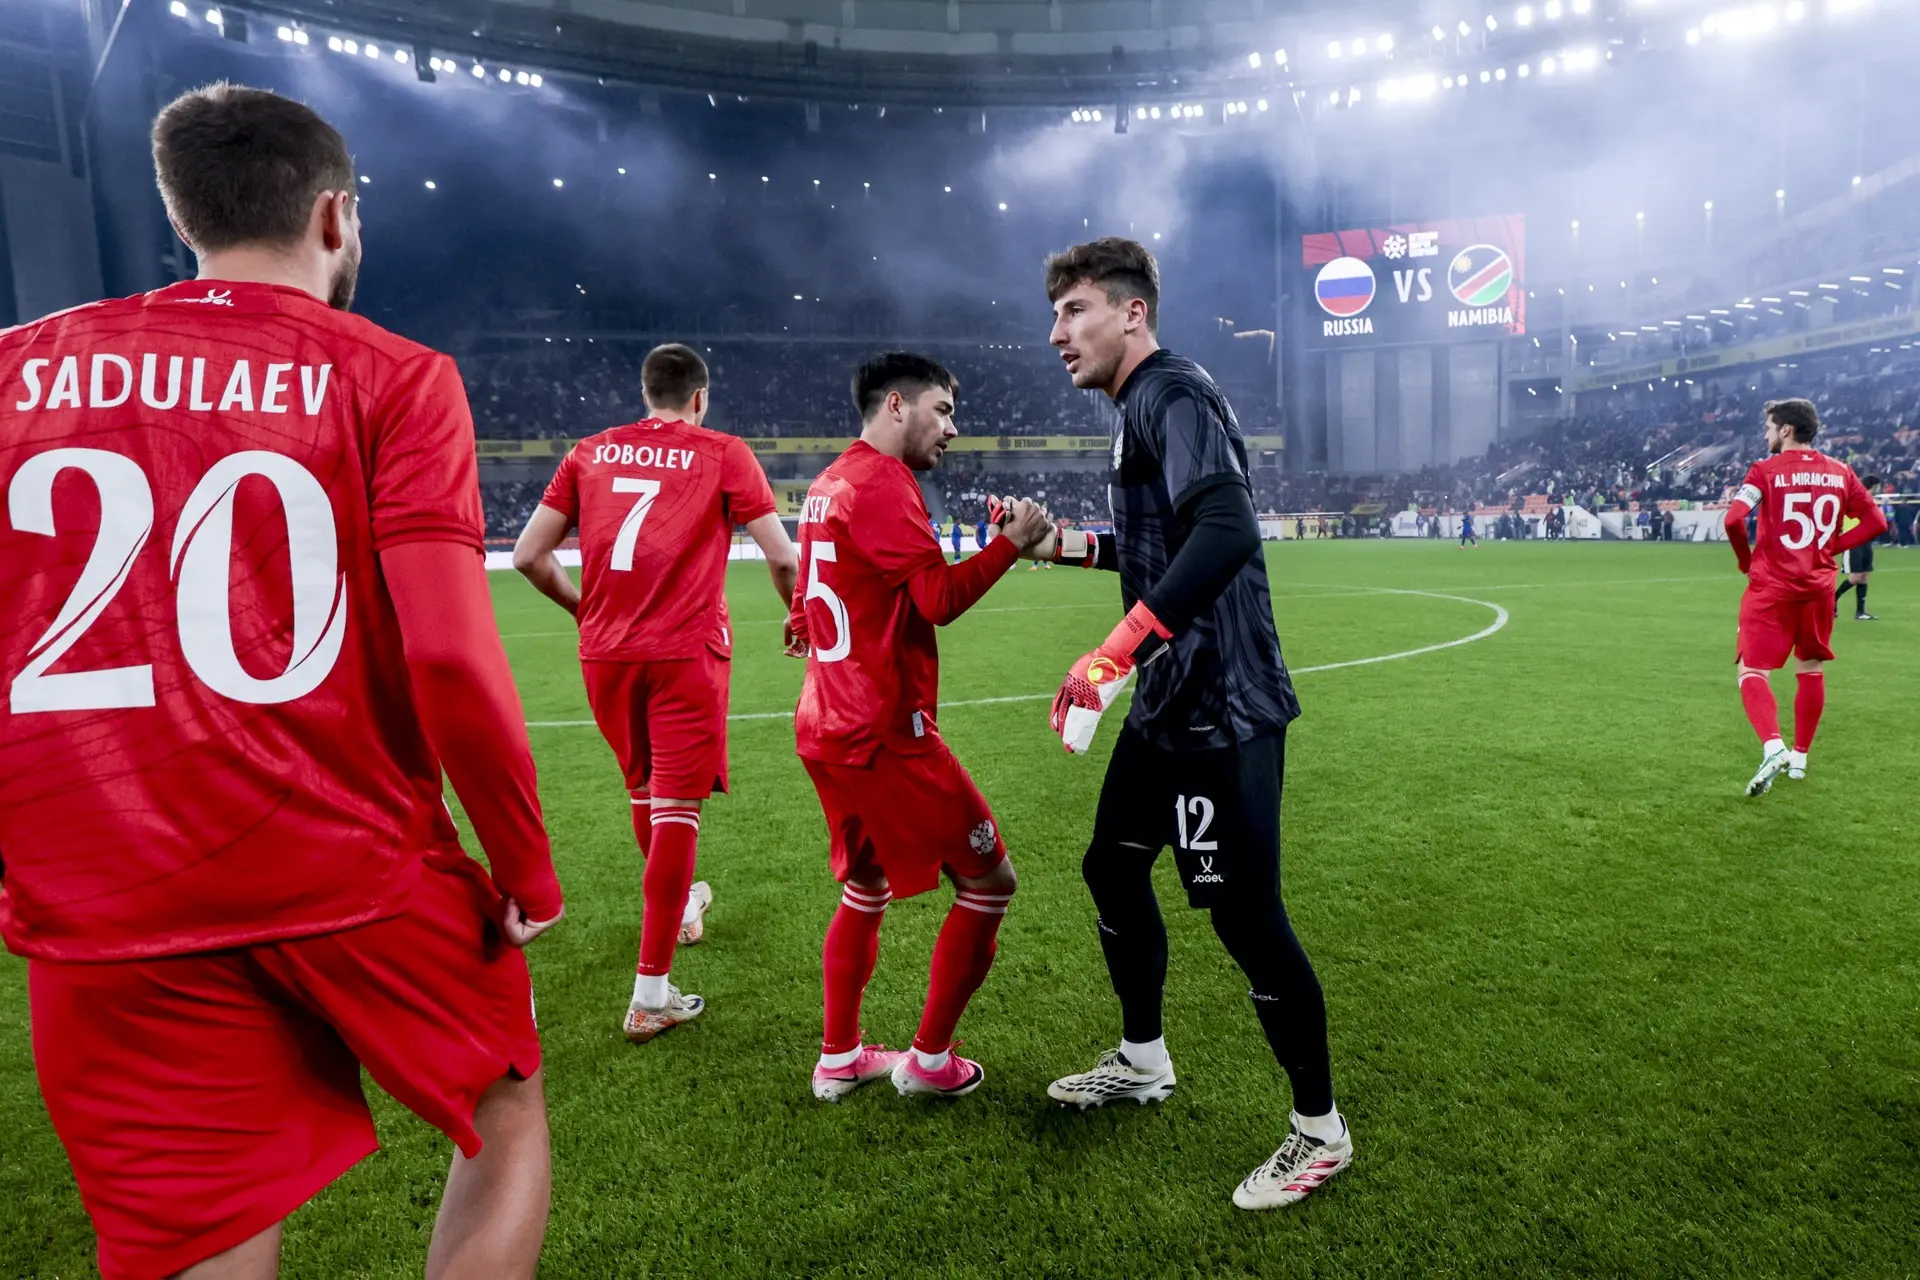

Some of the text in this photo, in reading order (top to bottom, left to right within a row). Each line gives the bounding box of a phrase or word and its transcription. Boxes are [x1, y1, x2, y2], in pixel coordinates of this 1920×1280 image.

[1393, 267, 1433, 303] VS
[1323, 317, 1374, 337] RUSSIA
[1448, 305, 1513, 327] NAMIBIA
[15, 352, 333, 416] SADULAEV
[592, 443, 695, 470] SOBOLEV
[610, 476, 661, 572] 7
[1779, 492, 1841, 550] 59
[8, 447, 347, 714] 20
[803, 540, 852, 662] 5
[1174, 794, 1218, 851] 12
[1192, 874, 1224, 883] JOGEL
